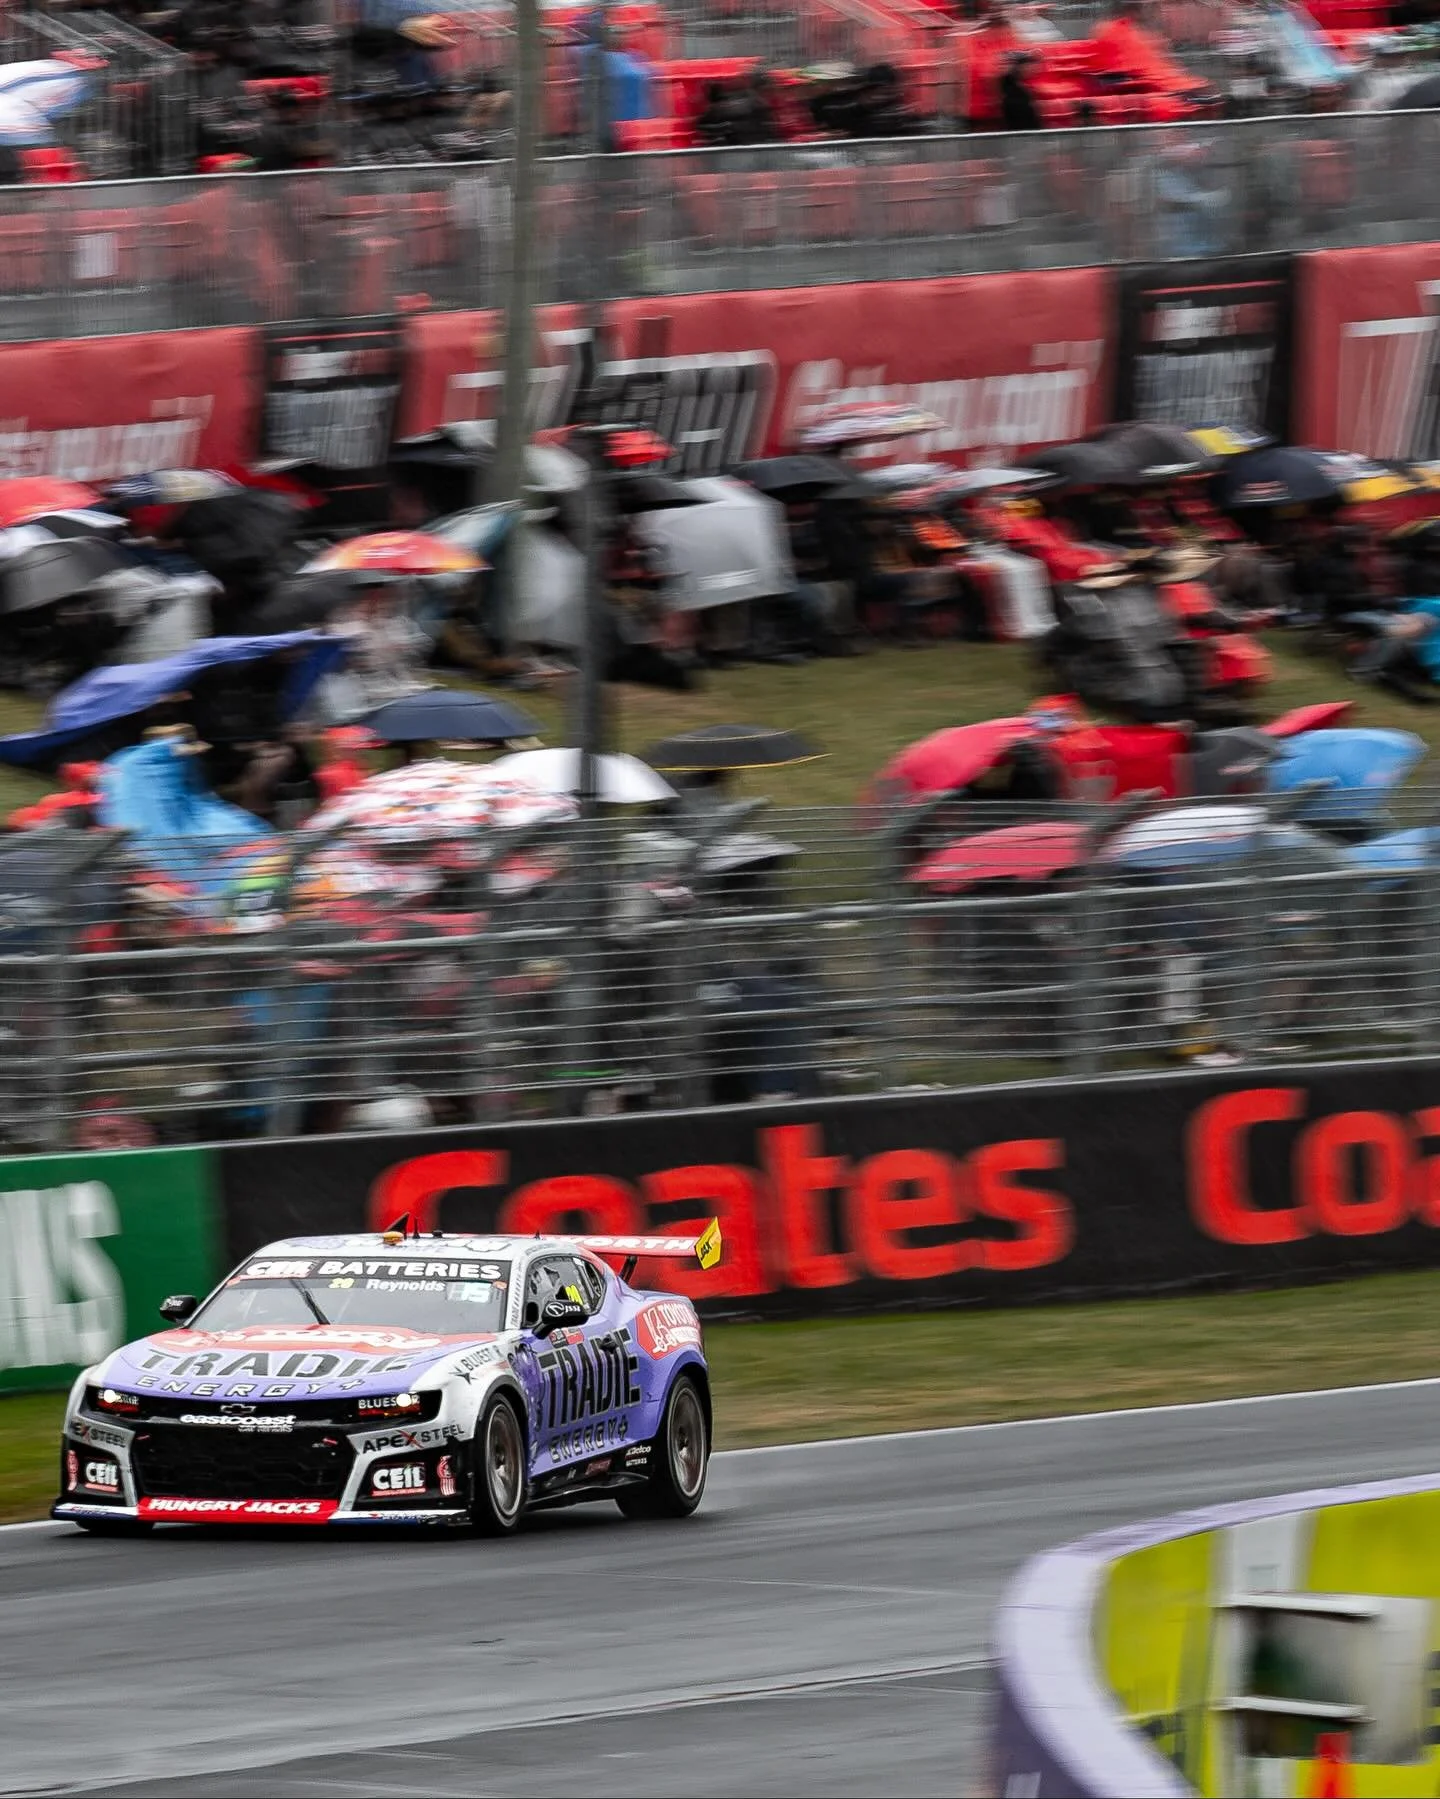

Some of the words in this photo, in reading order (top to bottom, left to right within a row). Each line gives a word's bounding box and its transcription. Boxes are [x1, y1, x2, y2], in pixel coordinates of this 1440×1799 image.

[1184, 1087, 1440, 1246] Co
[318, 1261, 501, 1279] BATTERIES
[366, 1280, 446, 1292] Reynolds
[657, 1303, 699, 1327] TOYOTA
[141, 1349, 422, 1378] TRADIE
[536, 1327, 641, 1429] TRADIE
[180, 1414, 297, 1425] eastcoast
[91, 1428, 127, 1449] STEEL
[362, 1430, 424, 1454] APEX
[421, 1423, 465, 1443] STEEL
[373, 1466, 425, 1490] CEIL
[149, 1499, 246, 1513] HUNGRY
